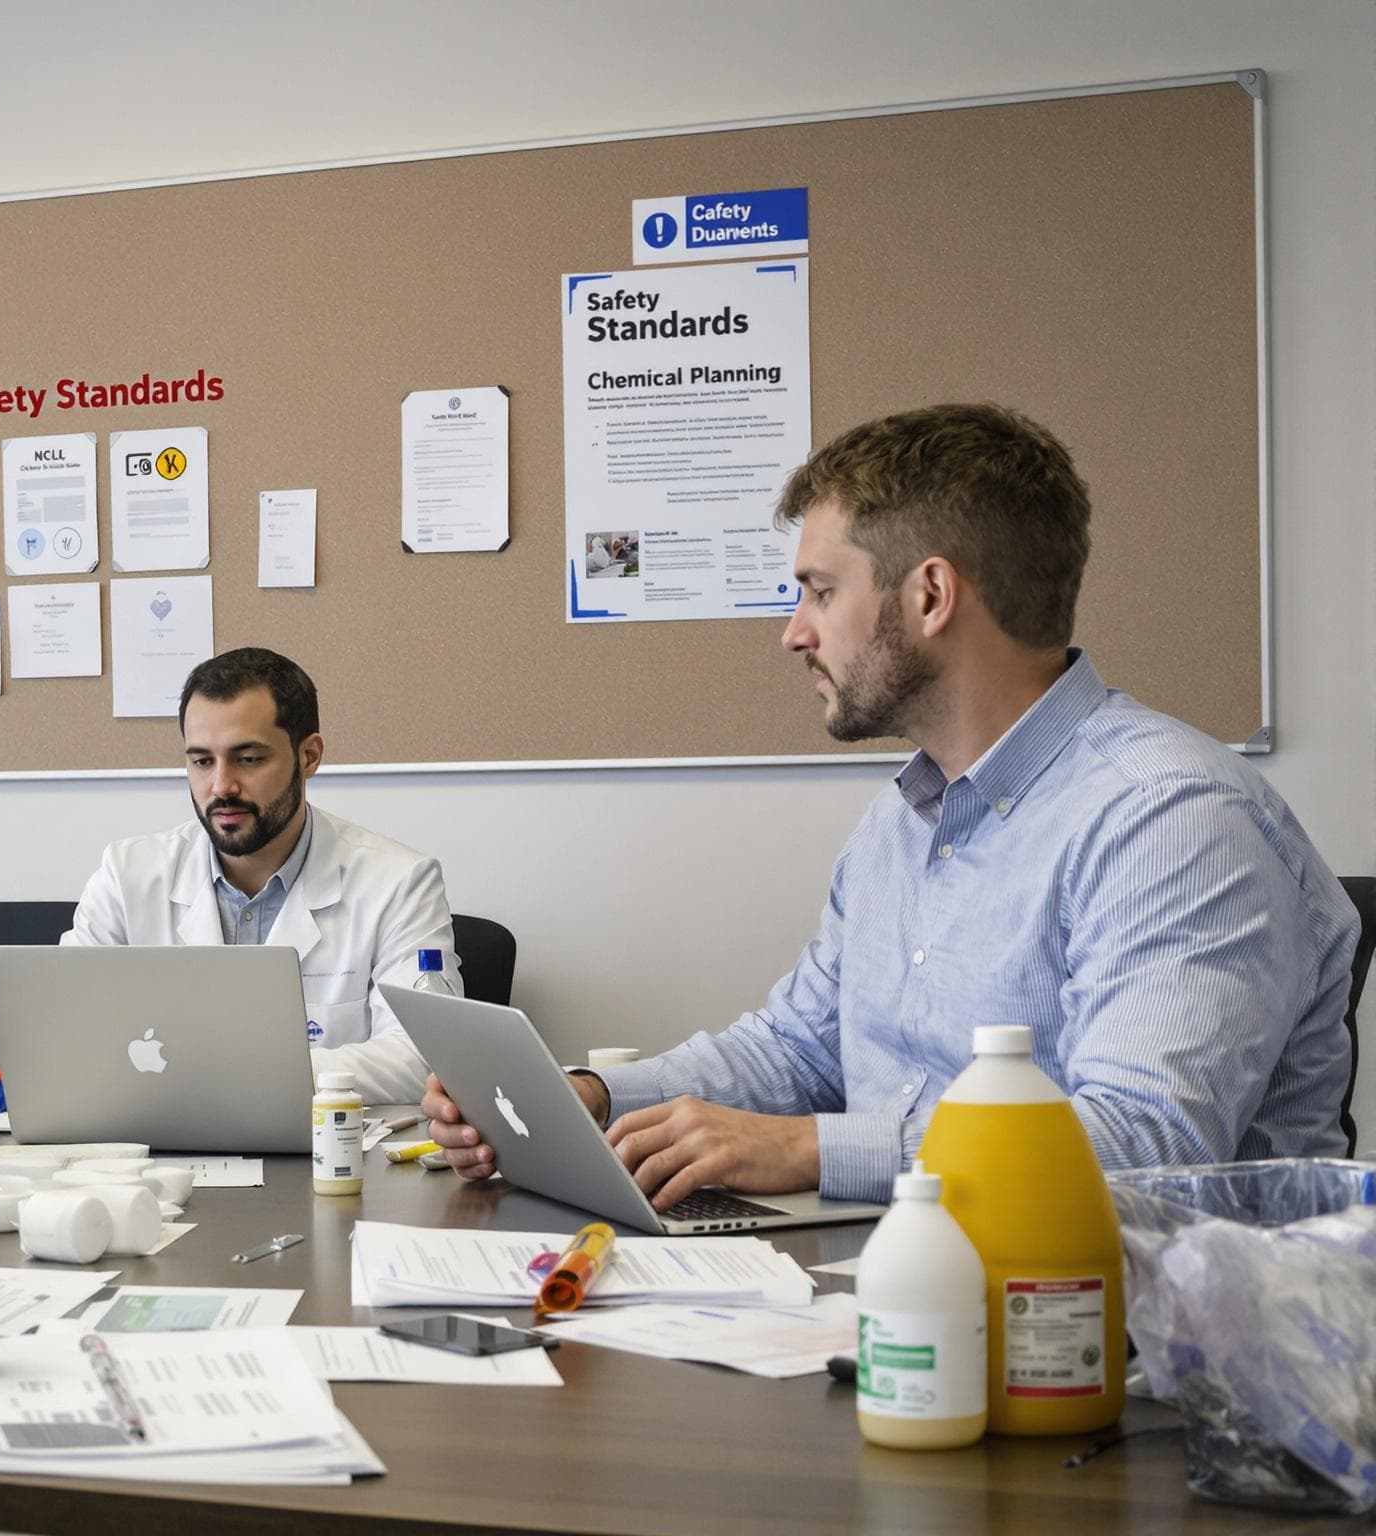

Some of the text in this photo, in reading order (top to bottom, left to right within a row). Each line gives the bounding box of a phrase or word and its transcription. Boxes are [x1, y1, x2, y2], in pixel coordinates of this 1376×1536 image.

[692, 202, 751, 221] Cafety
[587, 290, 659, 312] Safety
[587, 306, 749, 342] Standards
[56, 369, 224, 409] Standards
[588, 364, 781, 390] Chemical Planning
